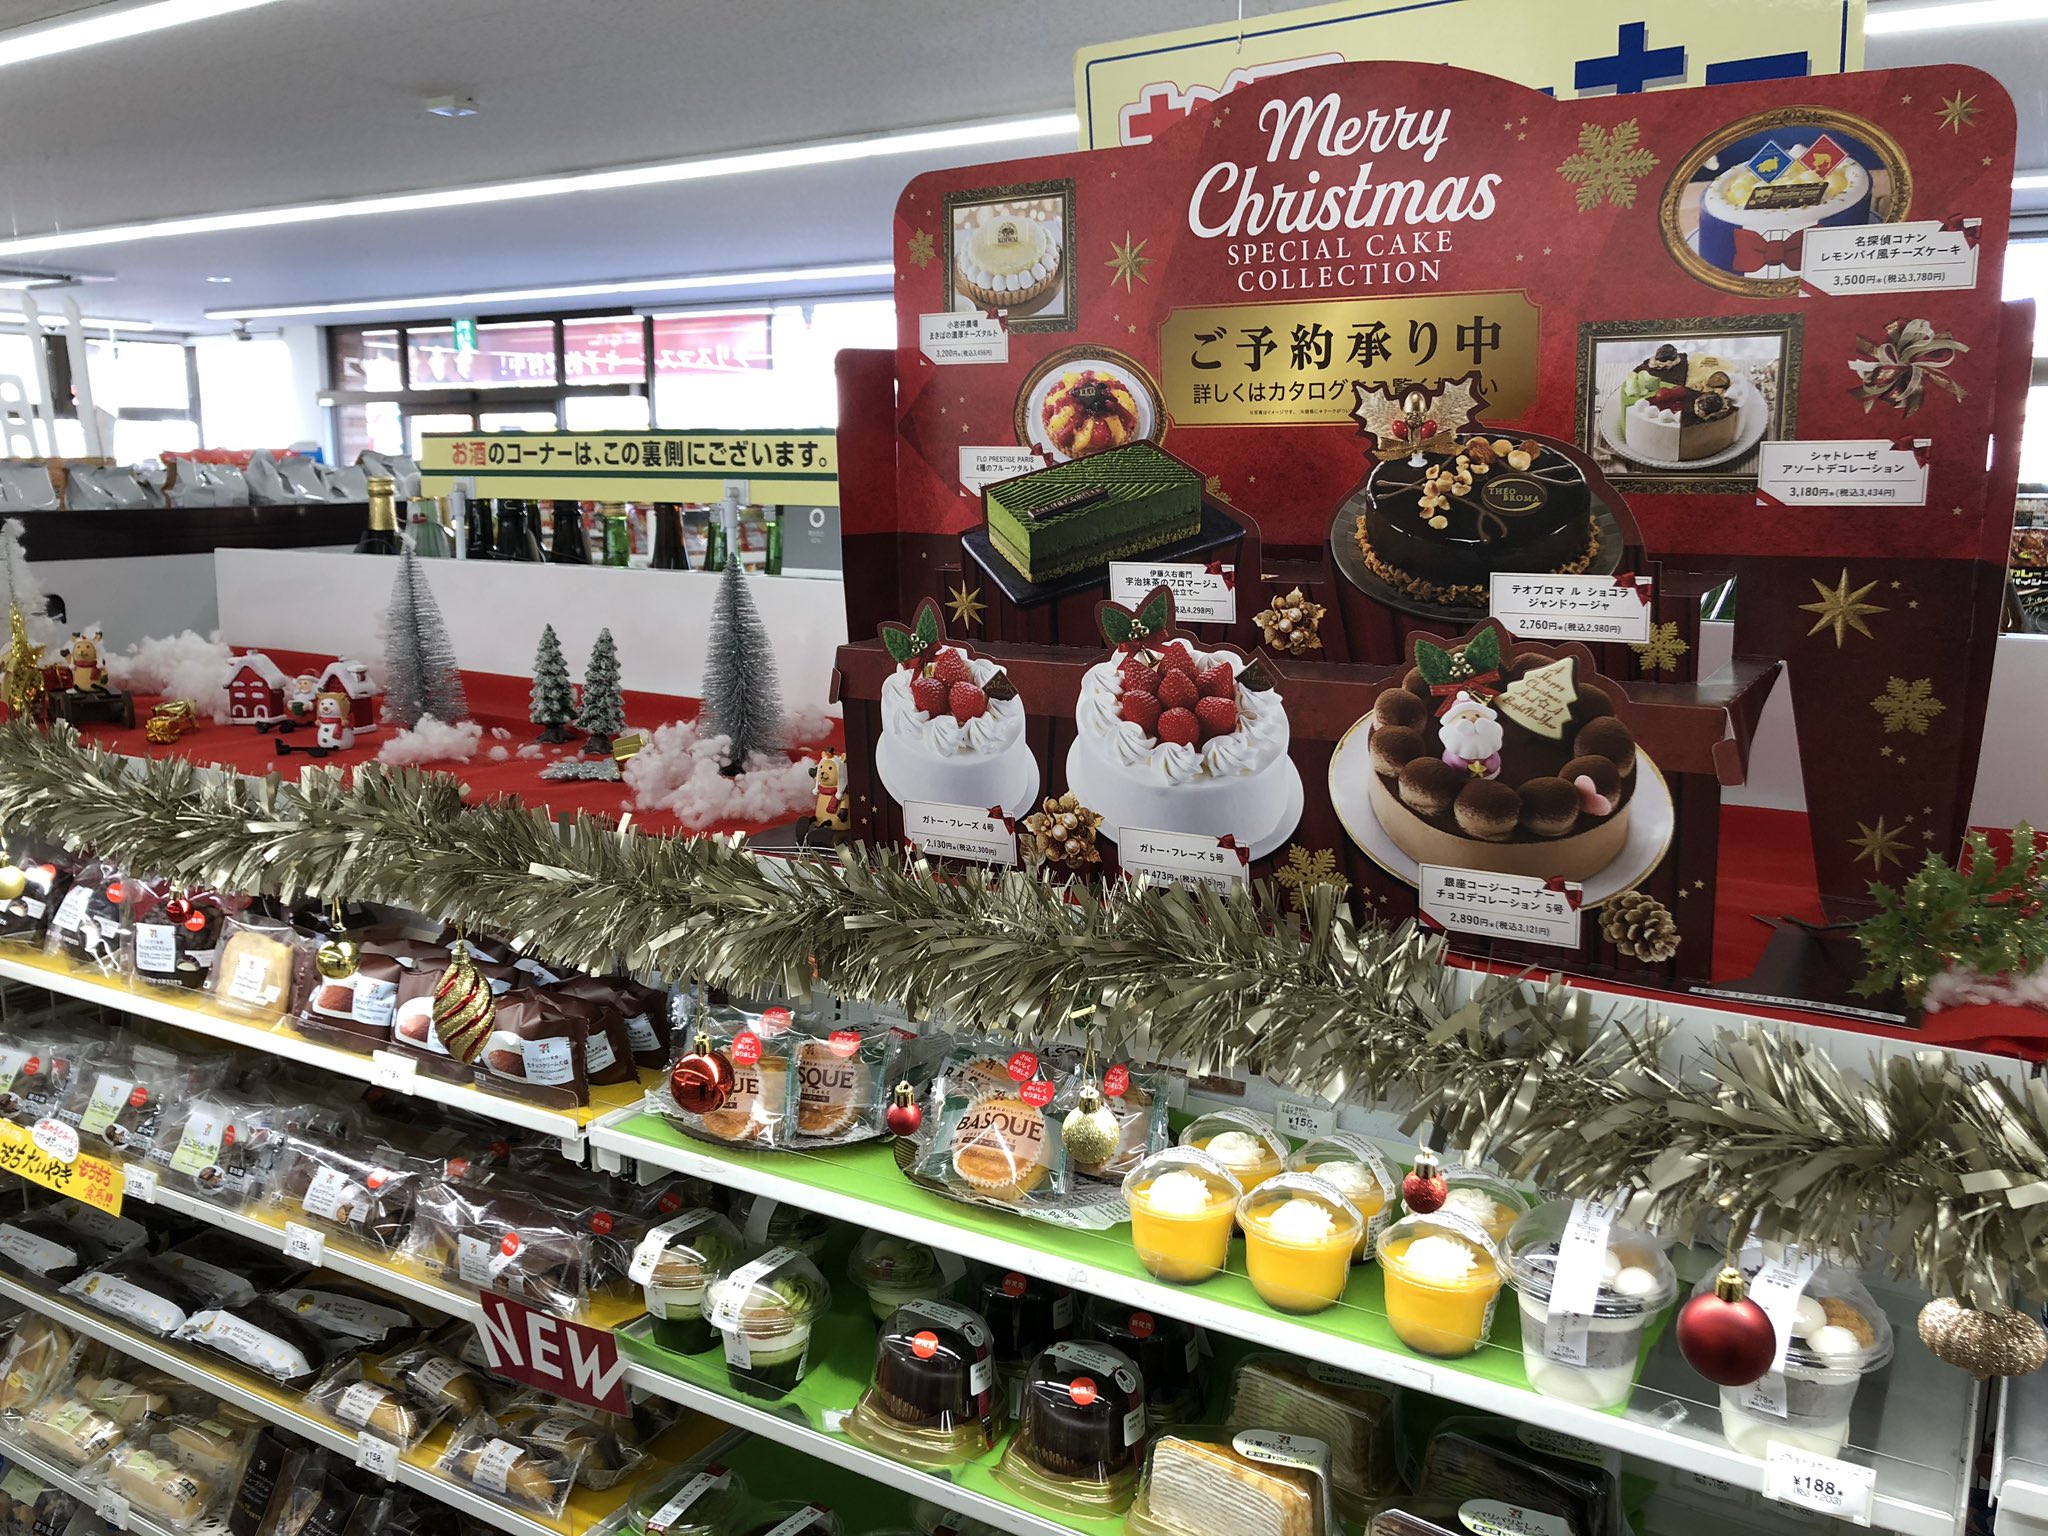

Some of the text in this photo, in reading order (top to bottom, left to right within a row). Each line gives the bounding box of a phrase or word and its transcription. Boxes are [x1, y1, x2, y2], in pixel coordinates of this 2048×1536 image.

[1259, 93, 1452, 163] Merry
[1188, 161, 1503, 239] Christmas
[1854, 231, 1928, 247] 名探偵コナン
[1227, 231, 1454, 266] SPECIAL CAKE
[1819, 243, 1961, 263] レモンパイ風チーズケーキ
[1237, 259, 1441, 293] COLLECTION
[947, 319, 979, 330] 小岩井農場
[929, 329, 998, 341] まきばの濃厚チーズタルト
[1191, 316, 1503, 372] ご予約承り中
[451, 440, 828, 469] お酒のコーナーは、この裏側にございます。
[976, 455, 1035, 464] FLO PRESTIGE PARIS
[1809, 448, 1879, 463] シャトレーゼ
[1782, 460, 1905, 475] アソートデコレーション
[1502, 493, 1541, 504] BROMA
[1149, 569, 1193, 579] 伊藤久右衛門
[1125, 576, 1219, 590] 宇治抹茶のフロマージュ
[1511, 583, 1629, 600] テオブロマ ル ショコラ
[1527, 598, 1611, 612] ジャンドゥージャ
[981, 821, 996, 834] 4号
[1208, 852, 1225, 865] 5号
[1443, 875, 1556, 898] 銀座コージーコーナー
[1435, 887, 1565, 916] チョコデコレーション 5号
[1009, 1064, 1030, 1078] なりました
[1014, 1059, 1032, 1070] おいしく
[1022, 1091, 1048, 1103] なりました
[1027, 1085, 1048, 1094] おいしく
[955, 1112, 1045, 1143] BASQUE
[473, 1302, 630, 1401] NEW
